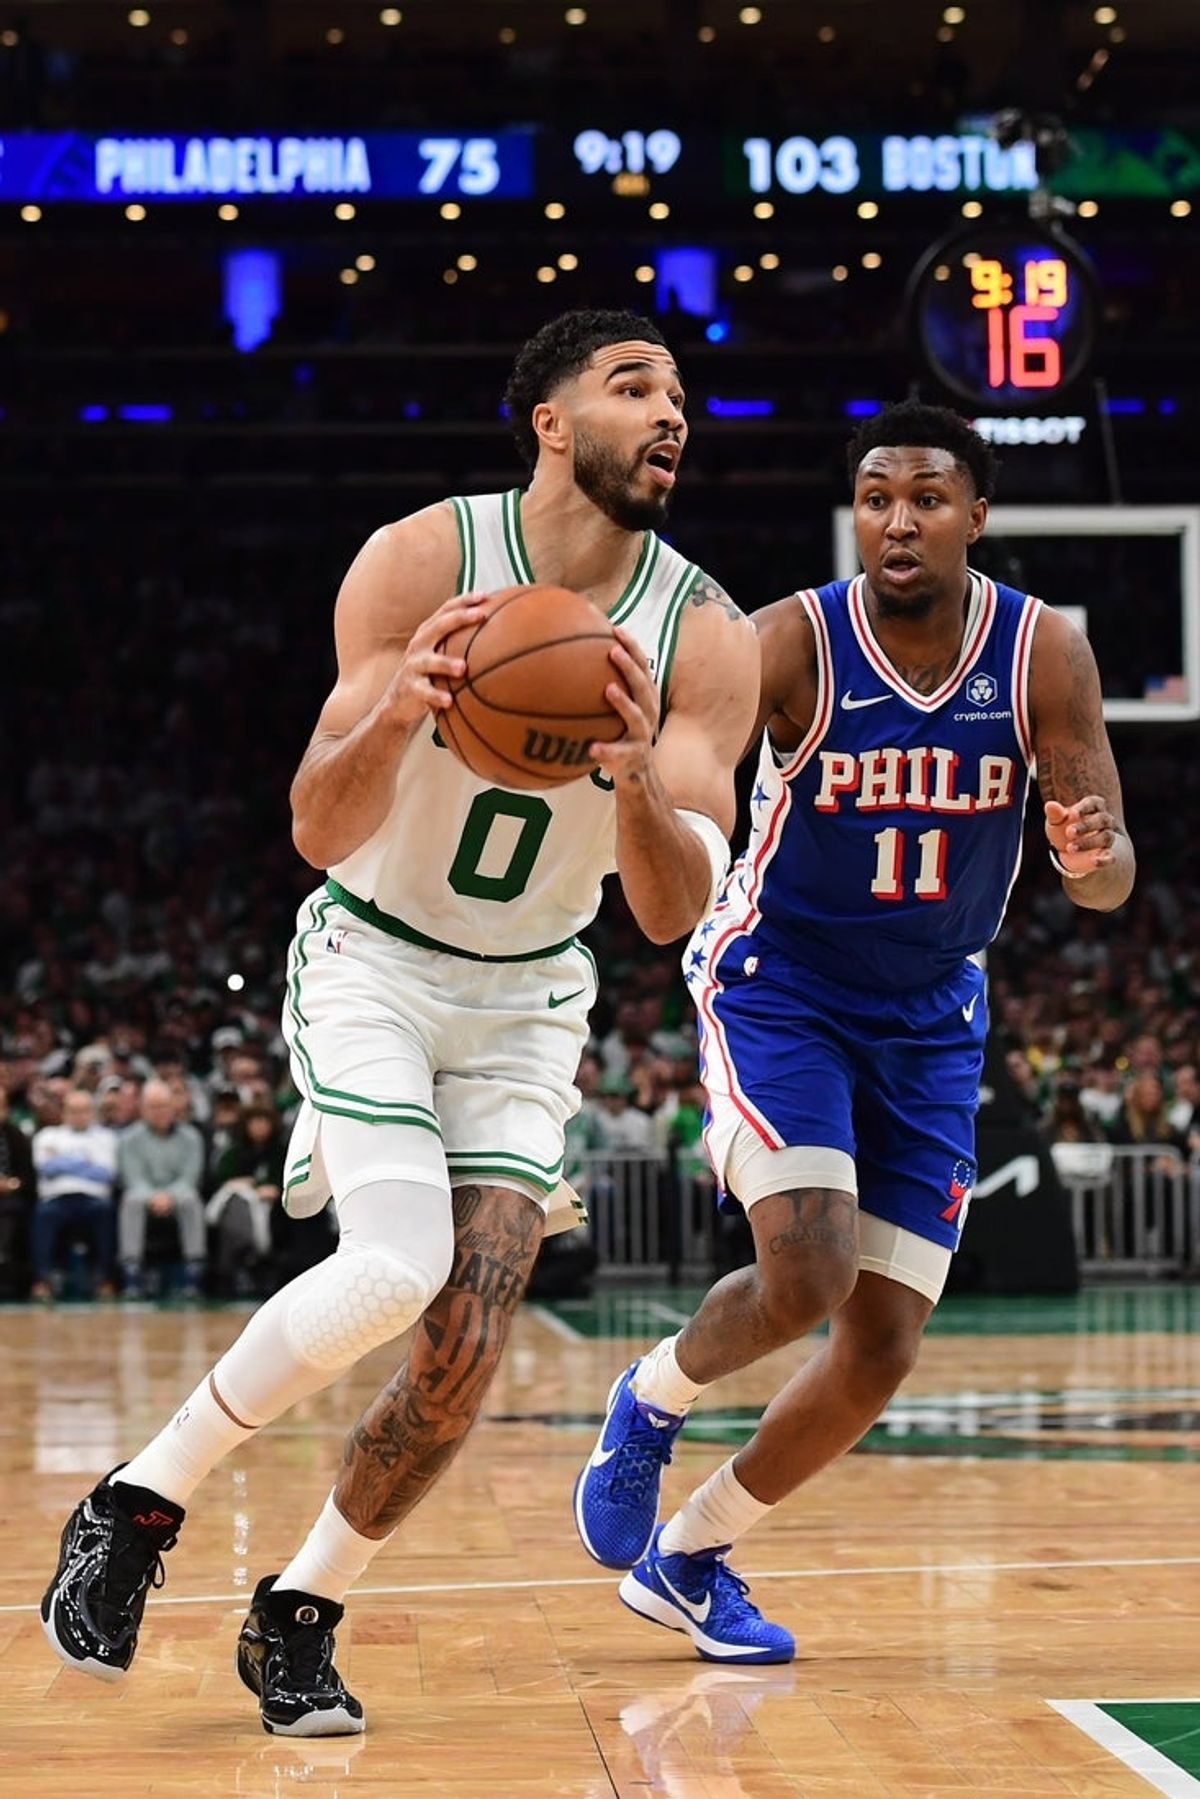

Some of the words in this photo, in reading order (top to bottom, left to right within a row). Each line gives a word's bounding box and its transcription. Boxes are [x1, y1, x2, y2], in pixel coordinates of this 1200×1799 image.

[96, 138, 371, 194] PHILADELPHIA
[418, 138, 500, 195] 75
[573, 129, 681, 175] 9:19
[743, 135, 860, 194] 103
[882, 134, 1038, 192] BOSTON
[970, 258, 1068, 308] 9:19
[987, 304, 1061, 388] 16
[974, 415, 1087, 445] TISSOT
[953, 710, 1012, 722] crypto.com
[524, 727, 598, 766] Wil
[814, 746, 1016, 815] PHILA
[447, 787, 553, 904] 0
[871, 827, 948, 901] 11
